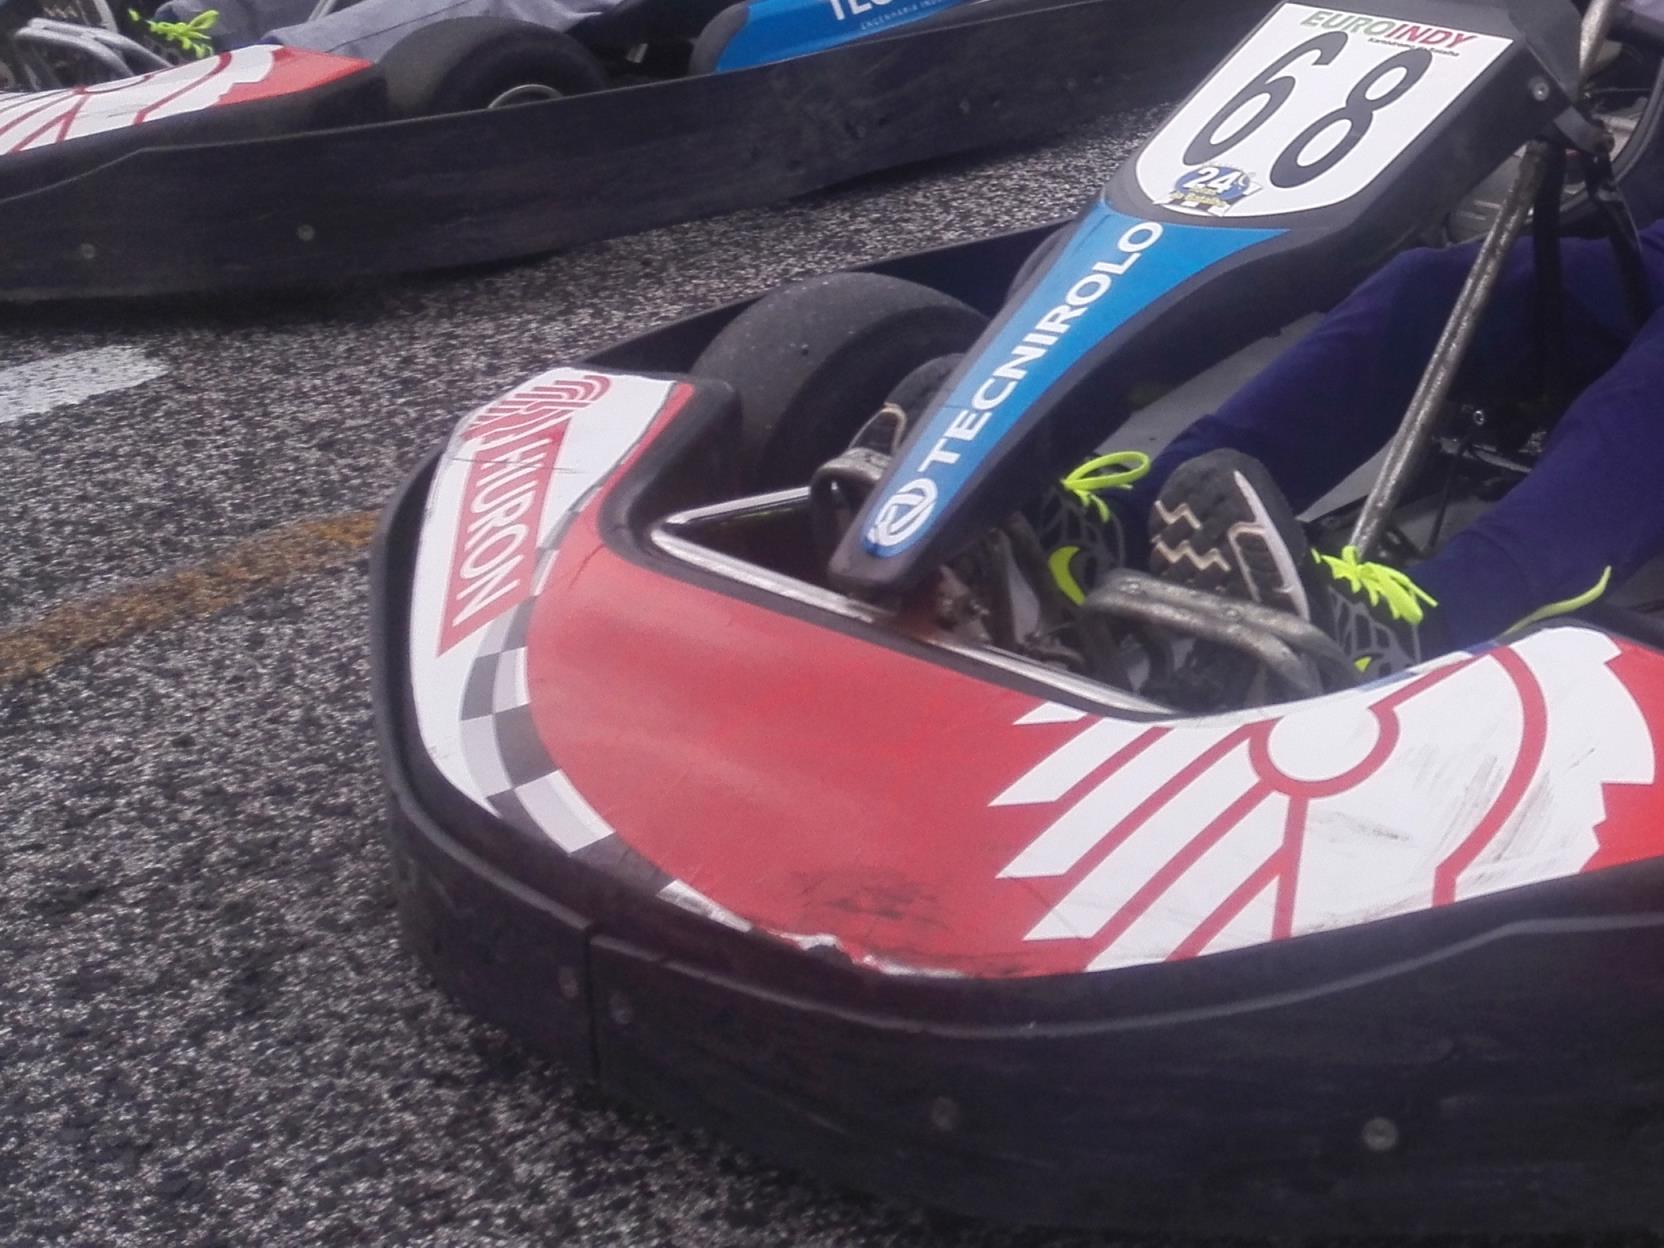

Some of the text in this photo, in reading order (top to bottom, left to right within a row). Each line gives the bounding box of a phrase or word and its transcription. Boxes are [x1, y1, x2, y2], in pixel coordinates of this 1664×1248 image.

[1300, 10, 1478, 48] EUROINDY
[1183, 30, 1433, 189] 68
[1183, 167, 1242, 193] 24
[918, 221, 1163, 472] TECNIROLO
[452, 436, 552, 628] HURON
